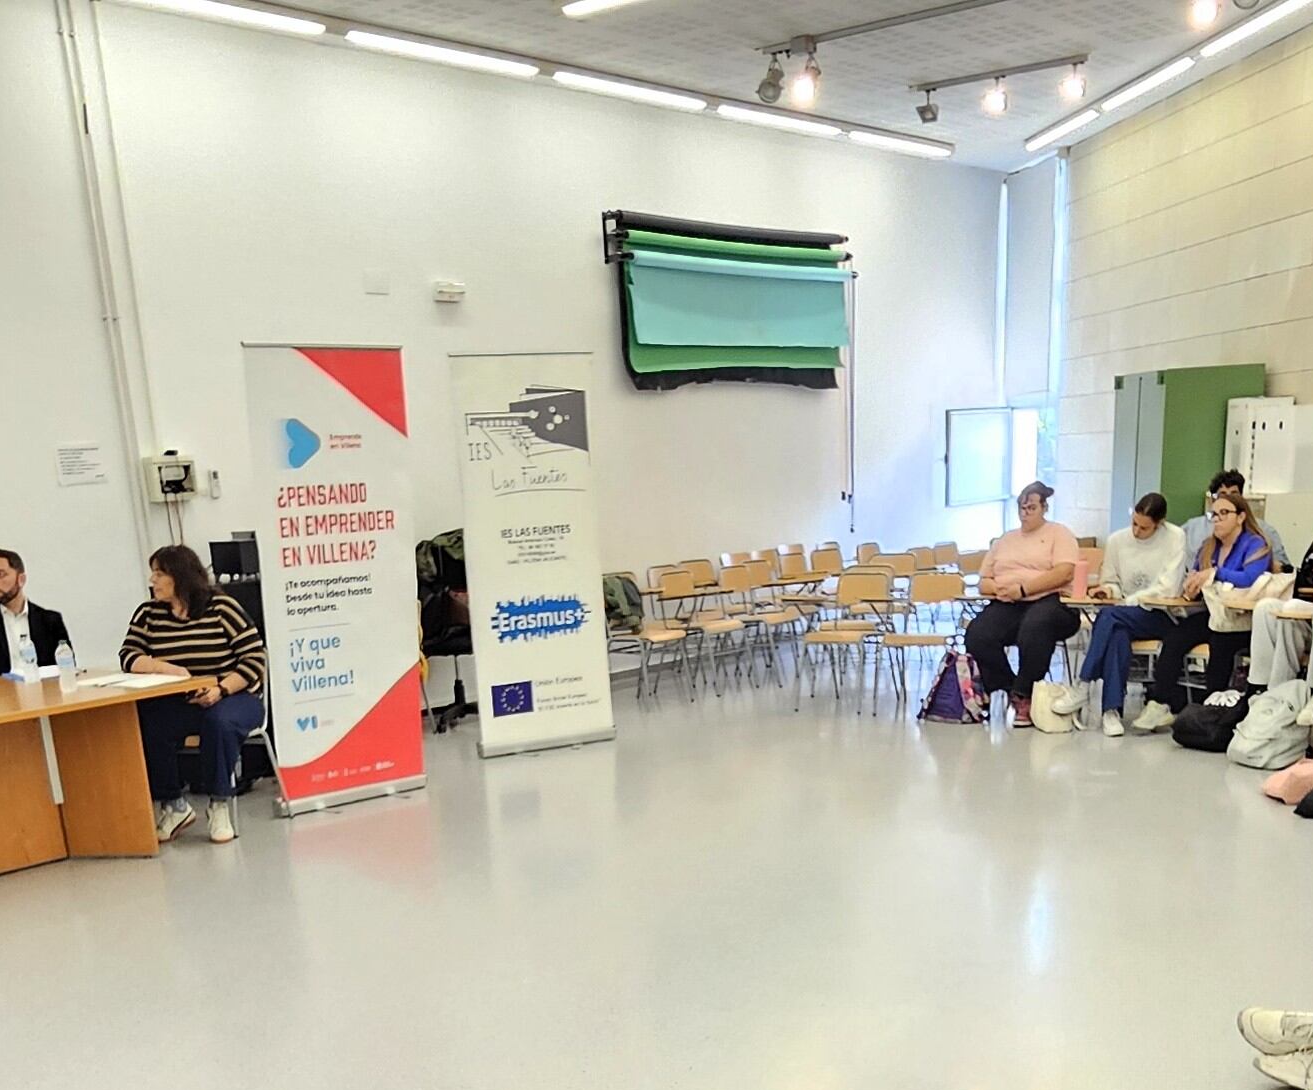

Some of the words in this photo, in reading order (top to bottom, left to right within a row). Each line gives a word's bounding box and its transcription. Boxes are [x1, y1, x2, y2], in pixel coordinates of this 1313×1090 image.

[277, 483, 367, 508] ¿PENSANDO
[280, 517, 300, 538] EN
[305, 510, 395, 537] EMPRENDER
[515, 527, 531, 537] LAS
[532, 524, 571, 536] FUENTES
[282, 546, 302, 568] EN
[307, 540, 377, 565] VILLENA?
[286, 592, 313, 603] Desde
[326, 589, 346, 598] idea
[348, 587, 372, 596] hasta
[287, 607, 295, 616] la
[499, 608, 586, 632] Erasmus+
[290, 638, 305, 657] ¡Y
[309, 636, 341, 655] que
[290, 657, 326, 673] viva
[292, 669, 354, 693] Villena!
